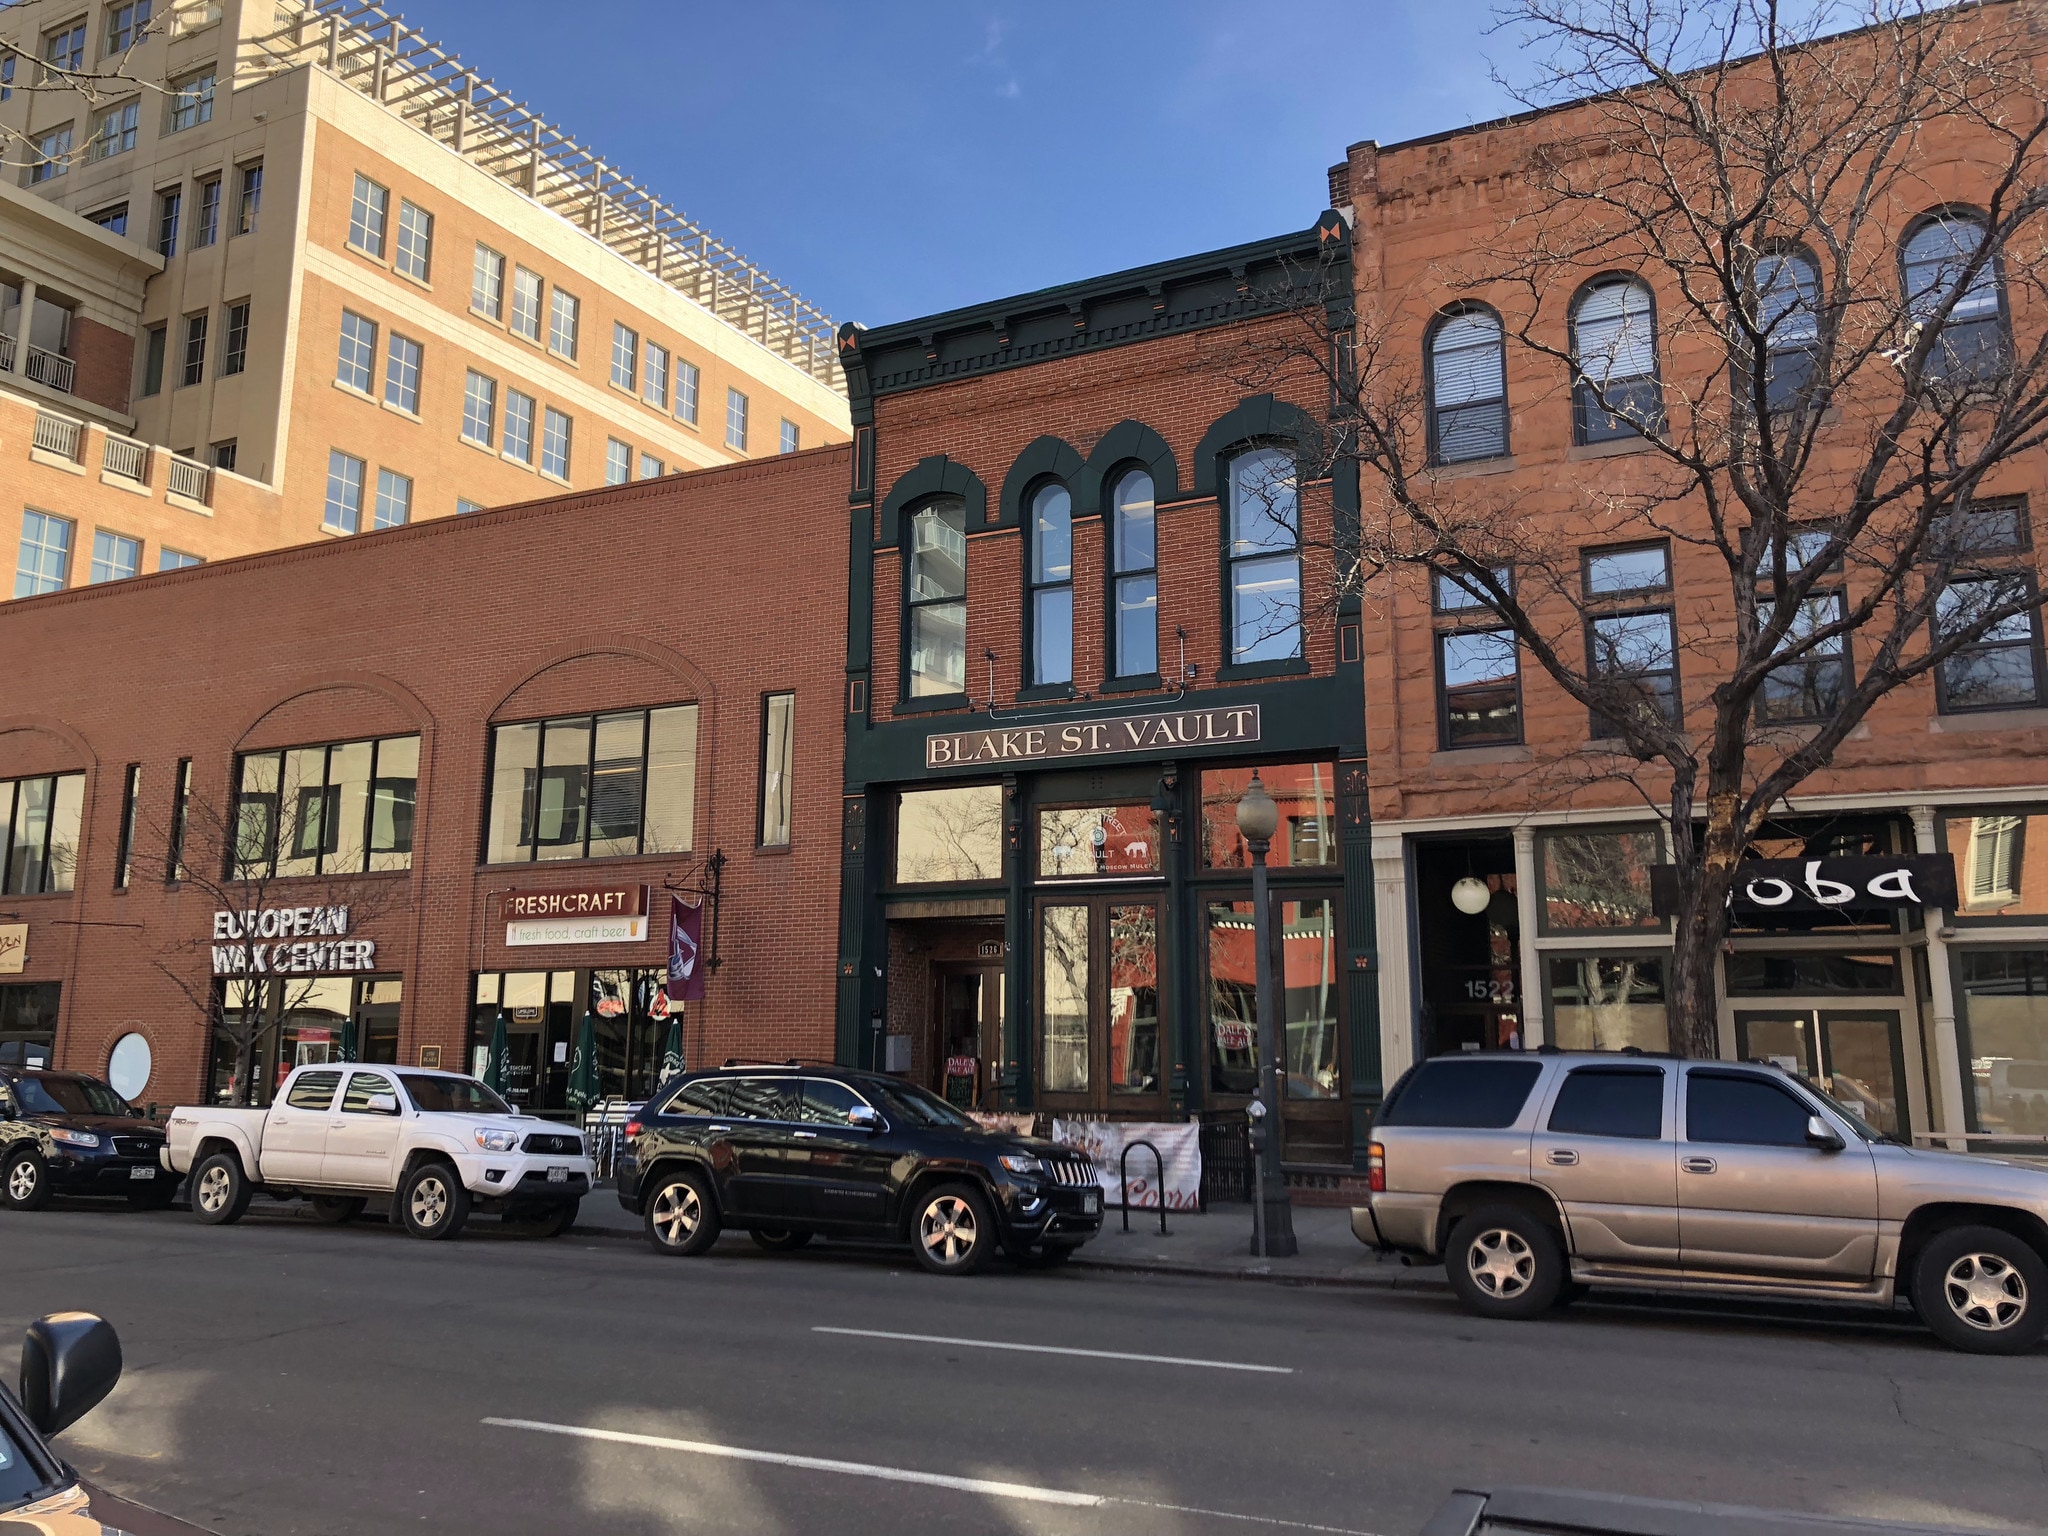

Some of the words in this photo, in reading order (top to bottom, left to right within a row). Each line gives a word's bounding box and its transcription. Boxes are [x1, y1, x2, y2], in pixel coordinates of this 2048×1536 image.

[929, 729, 1047, 764] BLAKE
[1060, 724, 1111, 752] ST.
[1123, 710, 1254, 747] VAULT
[1725, 860, 1922, 906] oba
[505, 892, 626, 915] FRESHCRAFT
[213, 905, 349, 940] EUROPEAN
[520, 928, 542, 941] fresh
[545, 926, 571, 940] food,
[574, 924, 599, 938] craft
[602, 923, 627, 938] beer
[212, 944, 269, 973] WAX
[272, 940, 376, 972] CENTER
[981, 945, 998, 954] 1526
[1464, 980, 1515, 998] 1522
